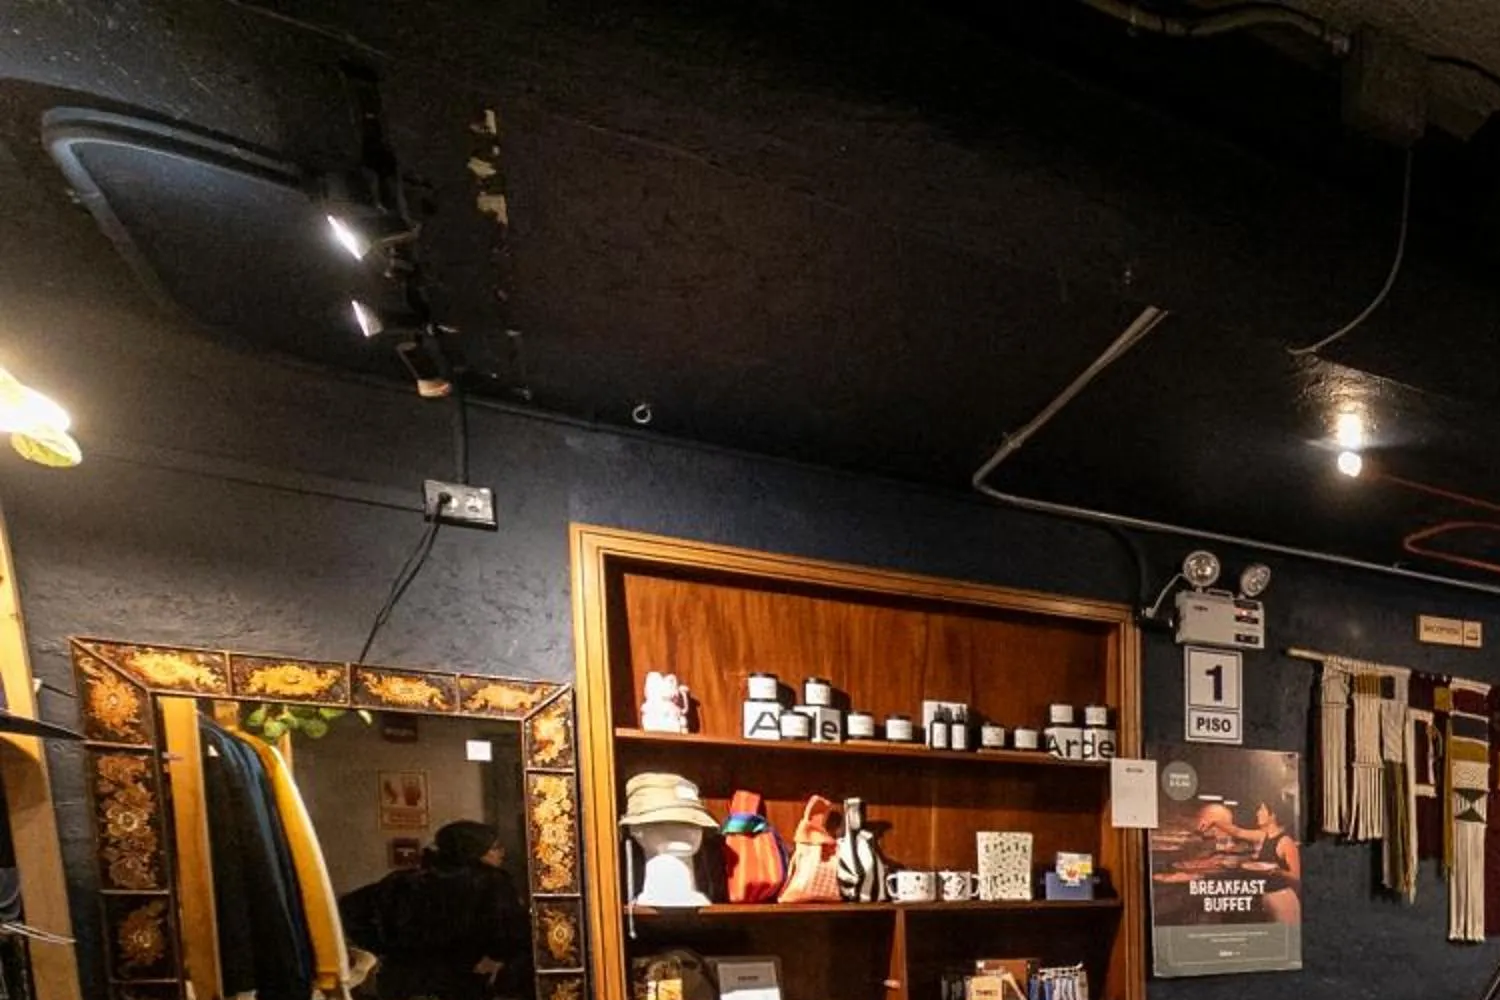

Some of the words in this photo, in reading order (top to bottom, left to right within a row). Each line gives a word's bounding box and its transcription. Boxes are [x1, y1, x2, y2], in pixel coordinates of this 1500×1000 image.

[1205, 665, 1223, 702] 1
[1196, 717, 1232, 733] PISO
[1047, 732, 1114, 759] Arde
[1189, 879, 1267, 896] BREAKFAST
[1203, 896, 1253, 912] BUFFET
